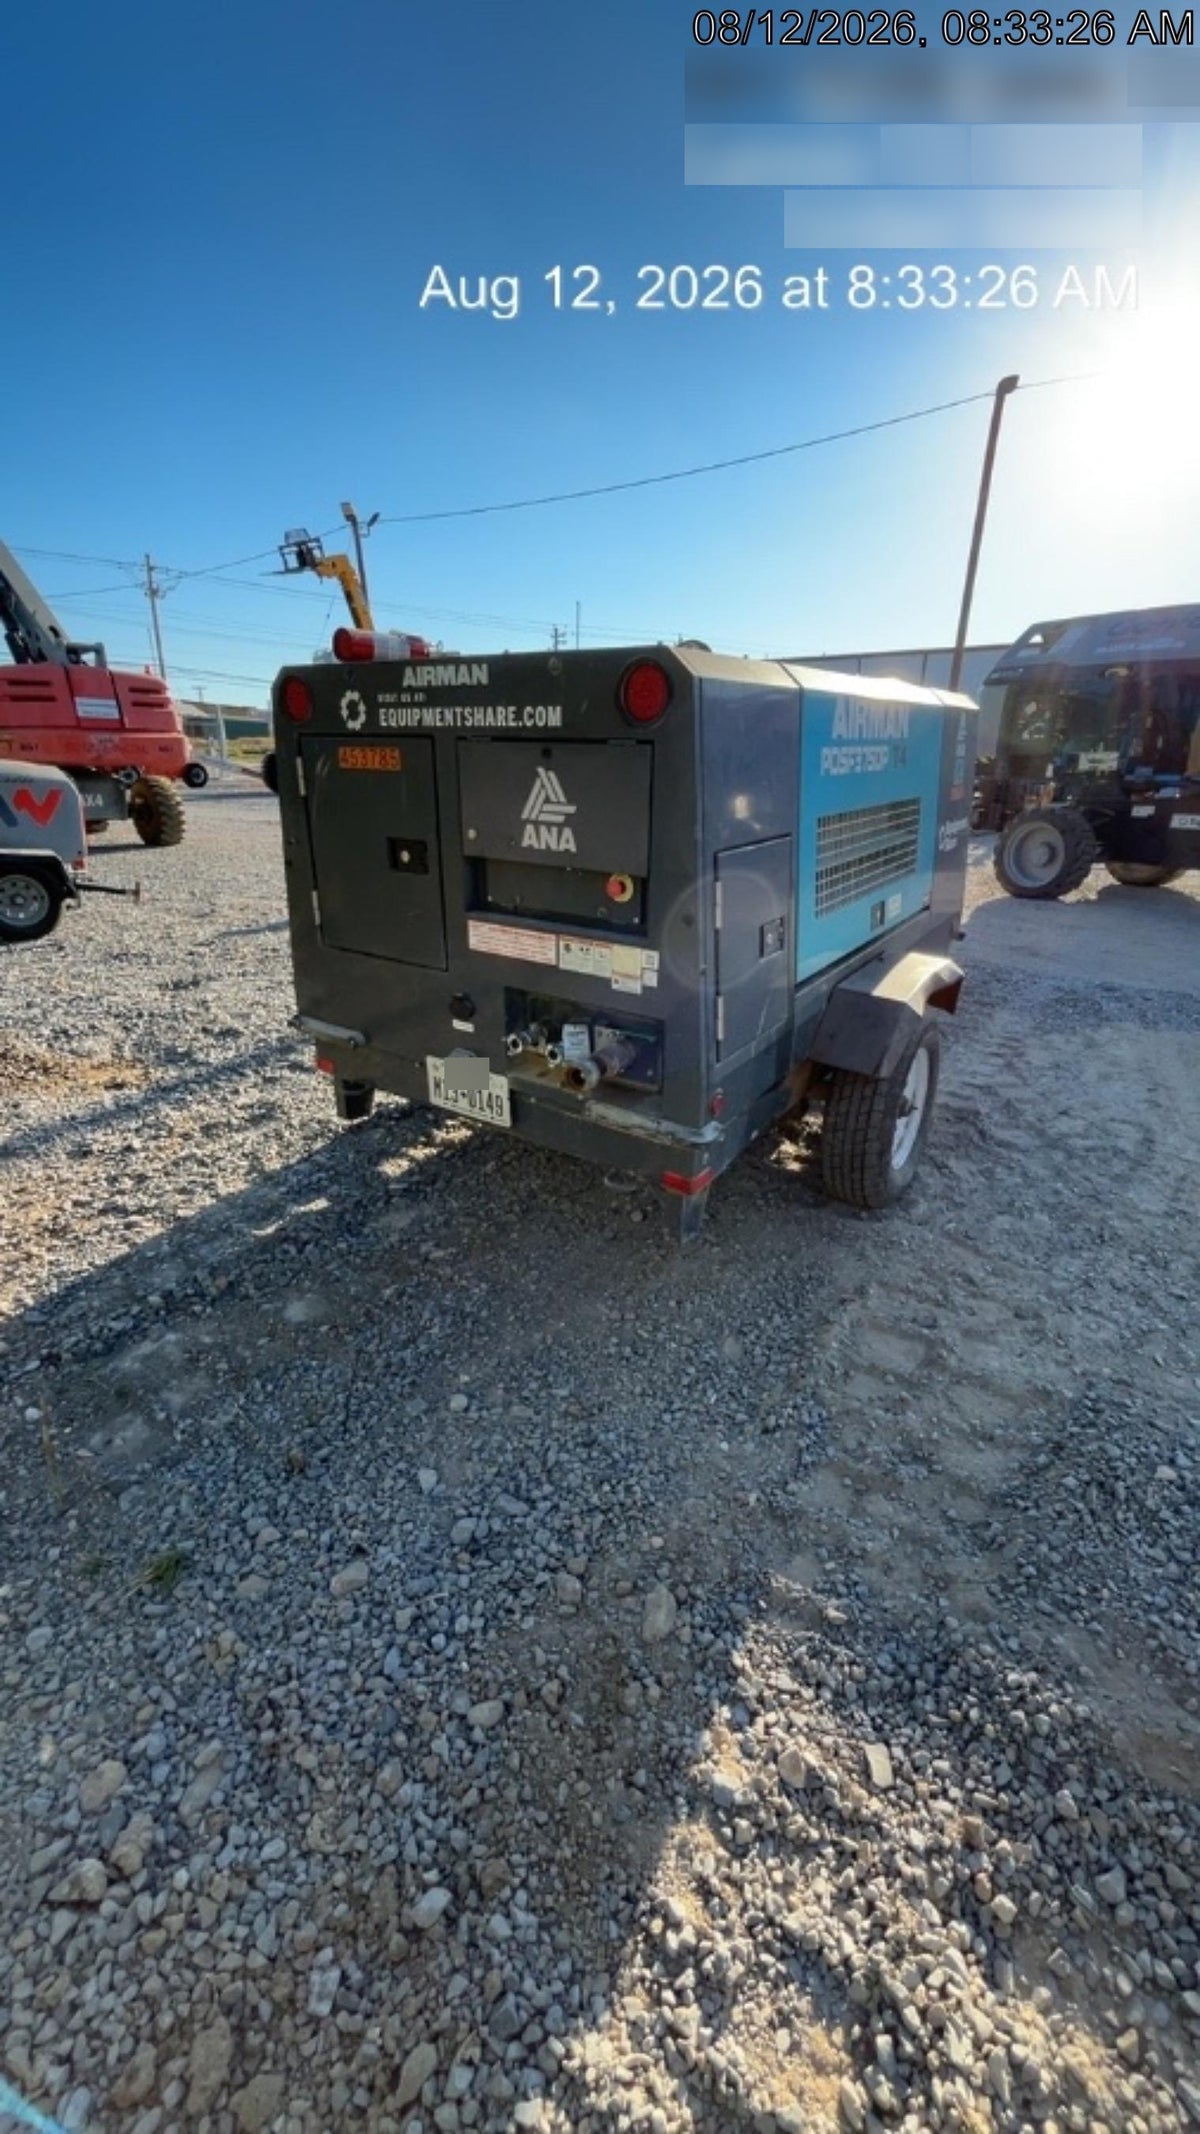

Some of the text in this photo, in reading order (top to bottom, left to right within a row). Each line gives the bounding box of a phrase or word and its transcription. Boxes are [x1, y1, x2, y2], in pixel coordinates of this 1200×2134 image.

[402, 663, 489, 688] AIRMAN
[378, 705, 562, 728] EQUIPMENTSHARE.COM
[832, 697, 909, 740] AIRMAN
[521, 824, 577, 852] ANA
